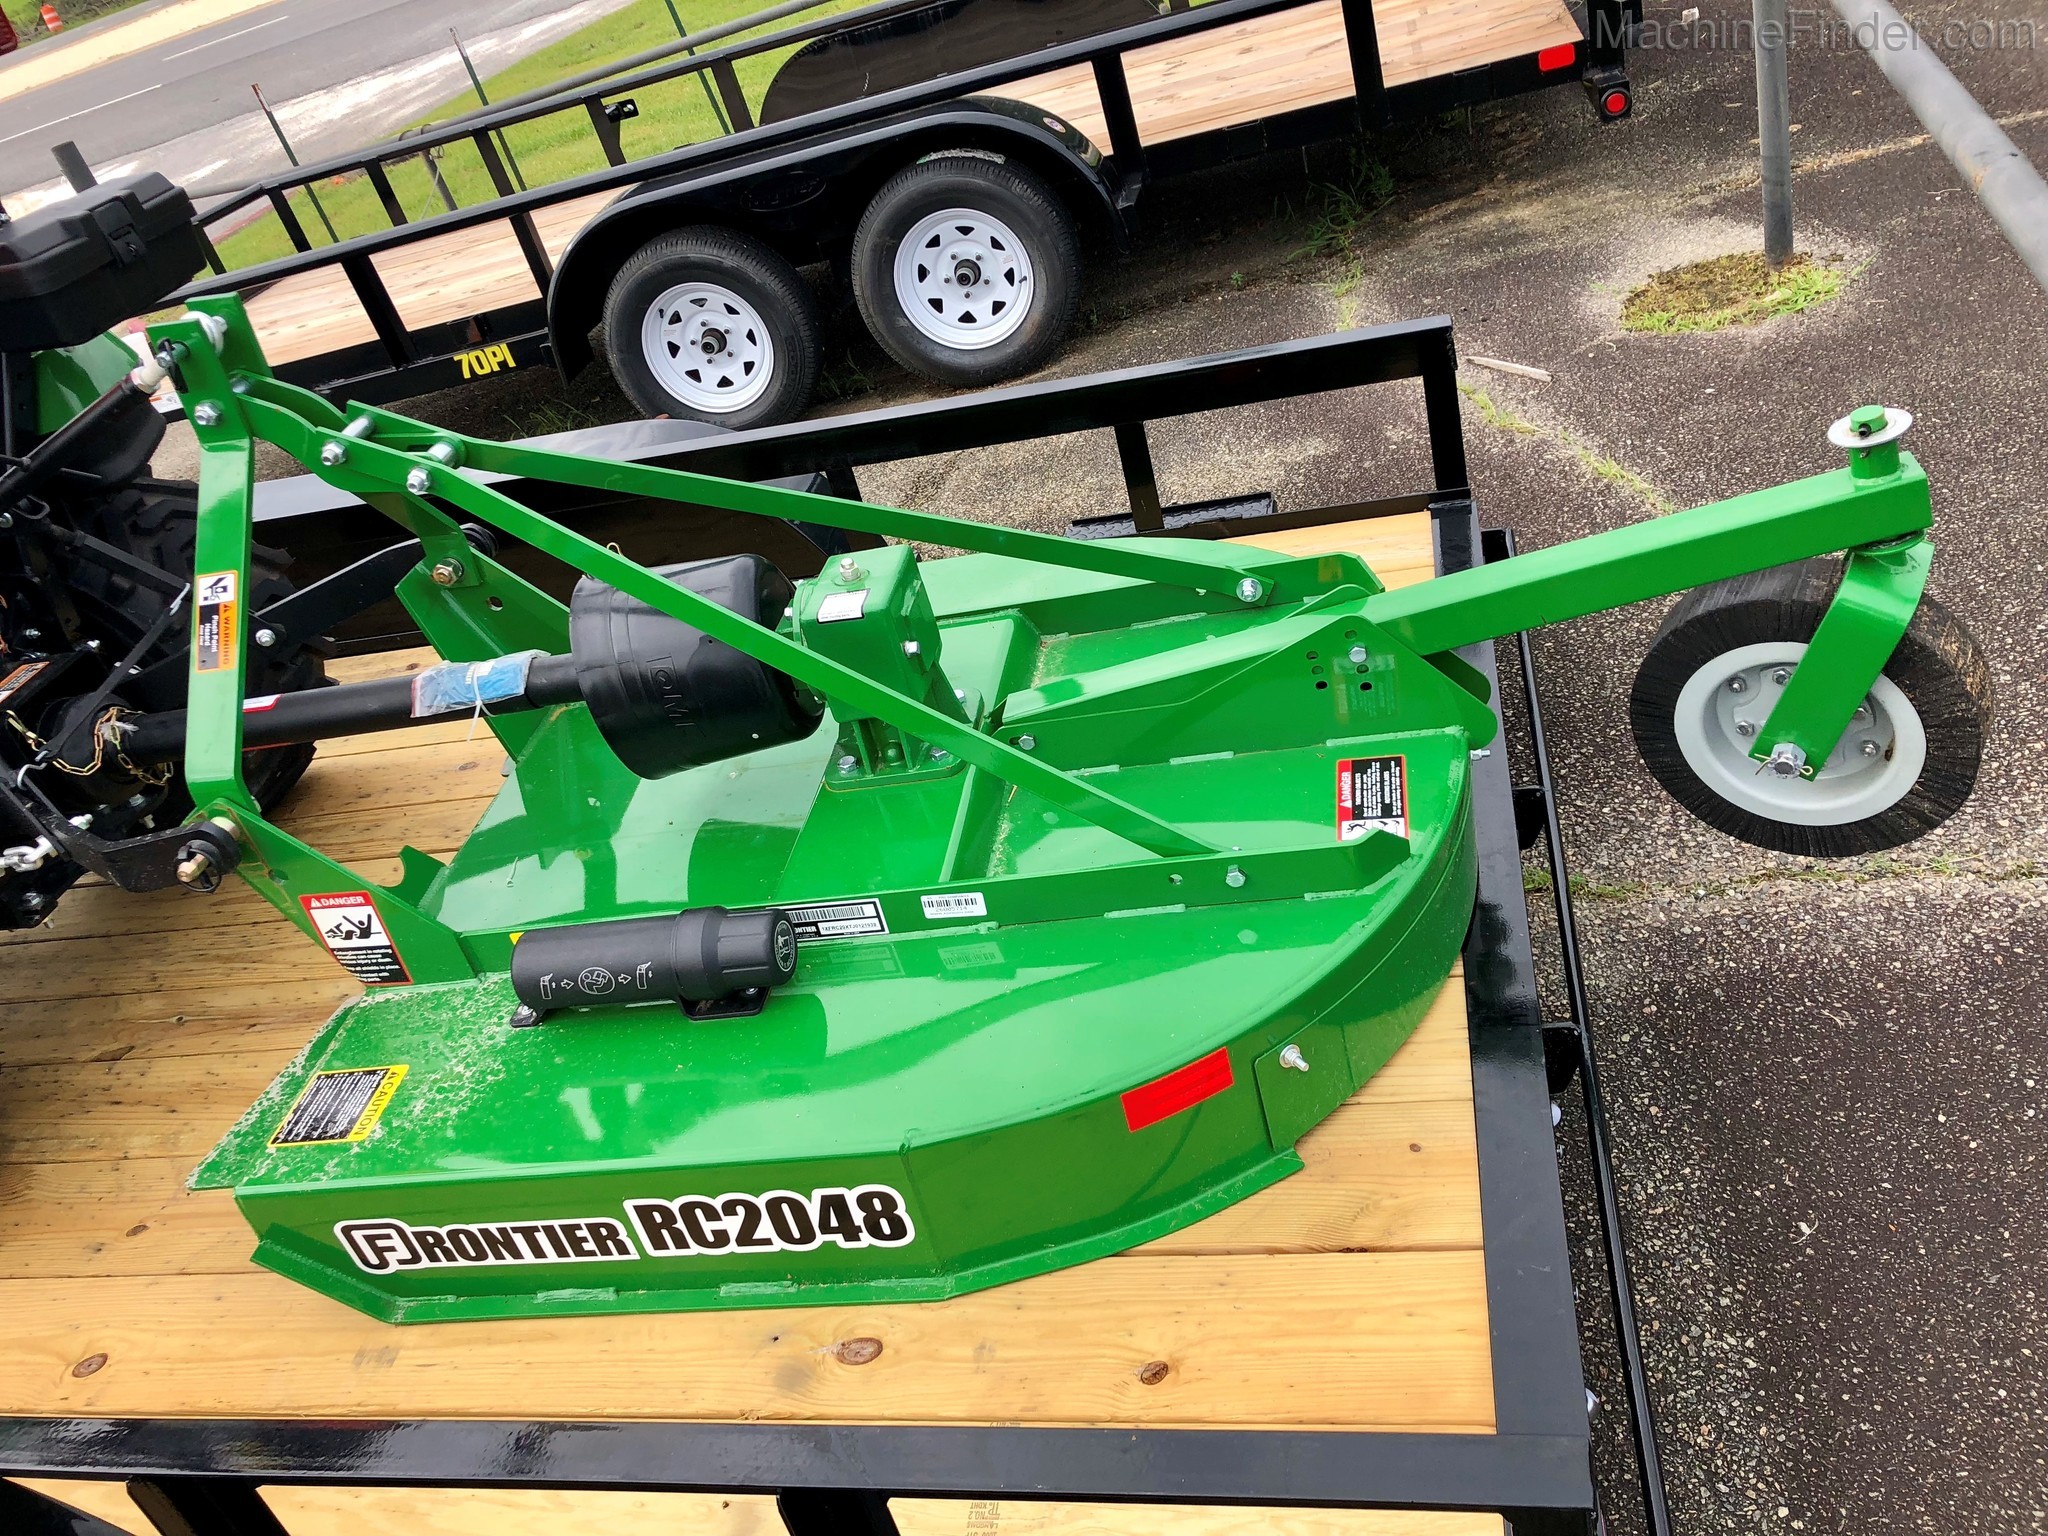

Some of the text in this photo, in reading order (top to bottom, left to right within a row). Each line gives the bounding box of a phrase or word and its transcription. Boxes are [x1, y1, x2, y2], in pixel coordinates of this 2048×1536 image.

[453, 343, 517, 379] 70PI
[211, 635, 219, 652] Point
[1341, 771, 1351, 800] DANGER
[321, 896, 365, 906] DANGER
[353, 1083, 394, 1136] CAUTION
[341, 1191, 908, 1271] FRONTIER RC2048
